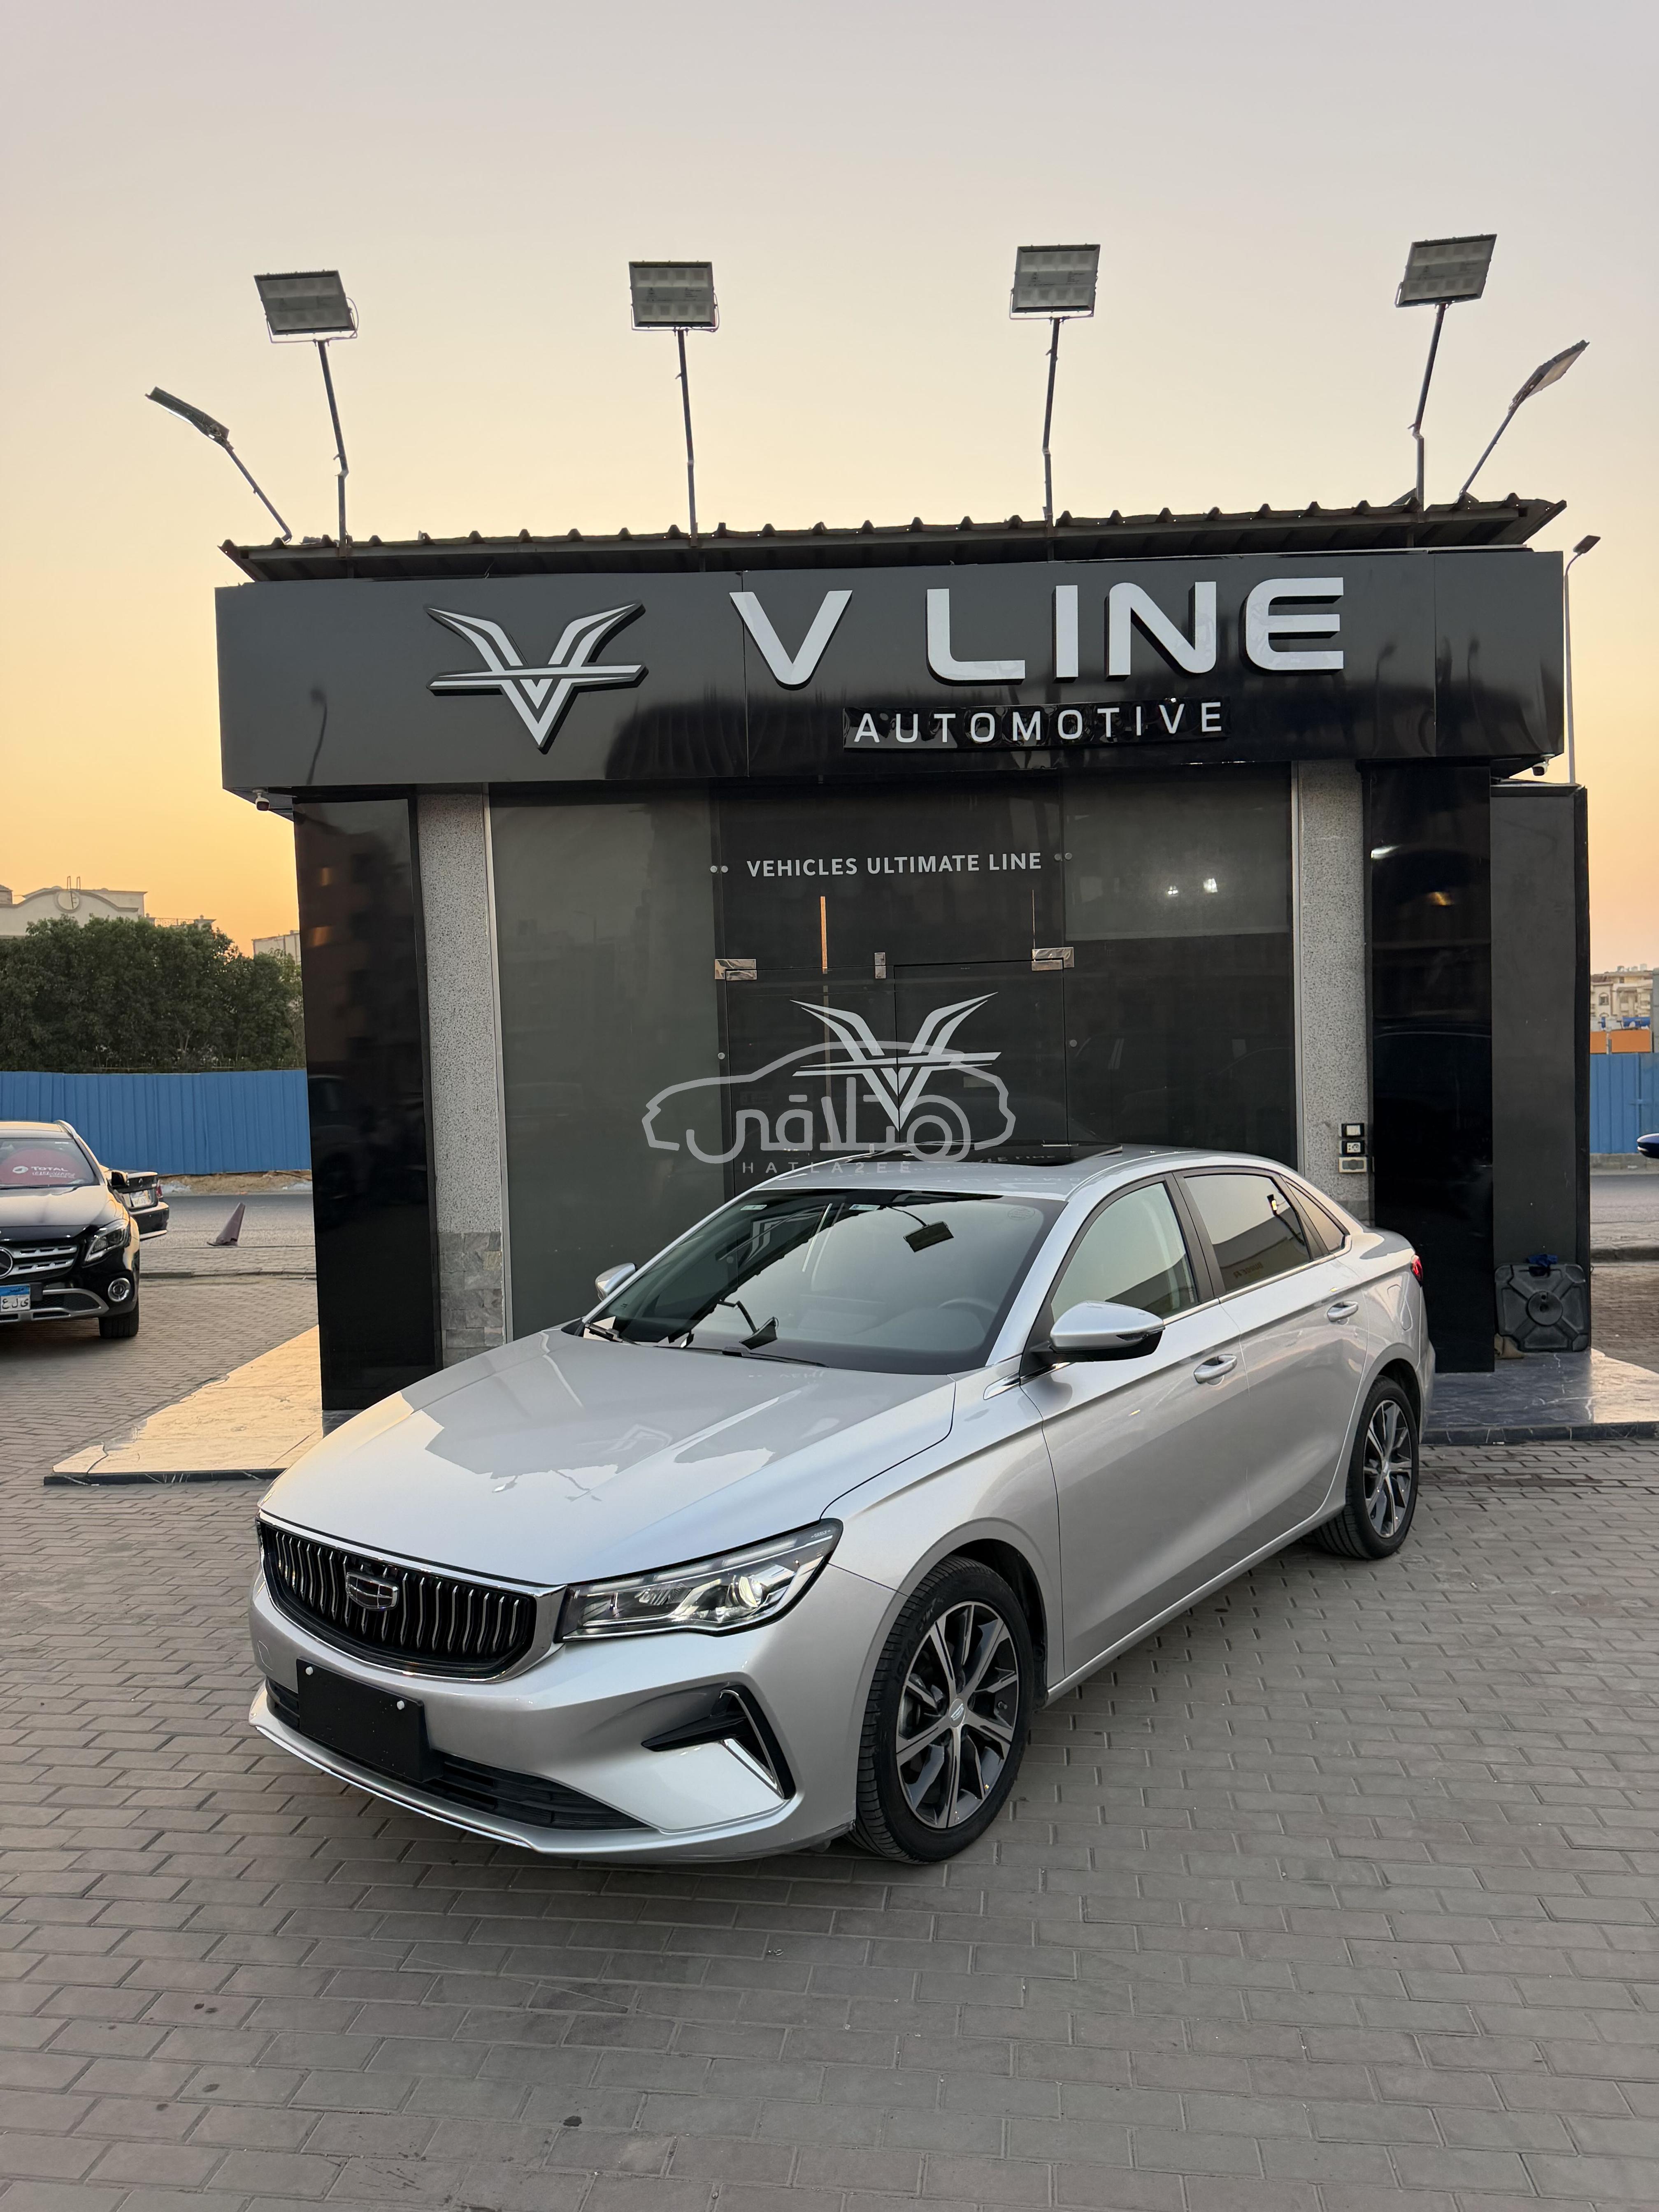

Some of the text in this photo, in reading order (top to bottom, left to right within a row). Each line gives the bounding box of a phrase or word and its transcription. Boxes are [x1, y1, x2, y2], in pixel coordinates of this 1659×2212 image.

[729, 577, 1344, 685] V LINE
[854, 702, 1221, 743] AUTOMOTIVE
[746, 853, 1041, 877] VEHICLES ULTIMATE LINE
